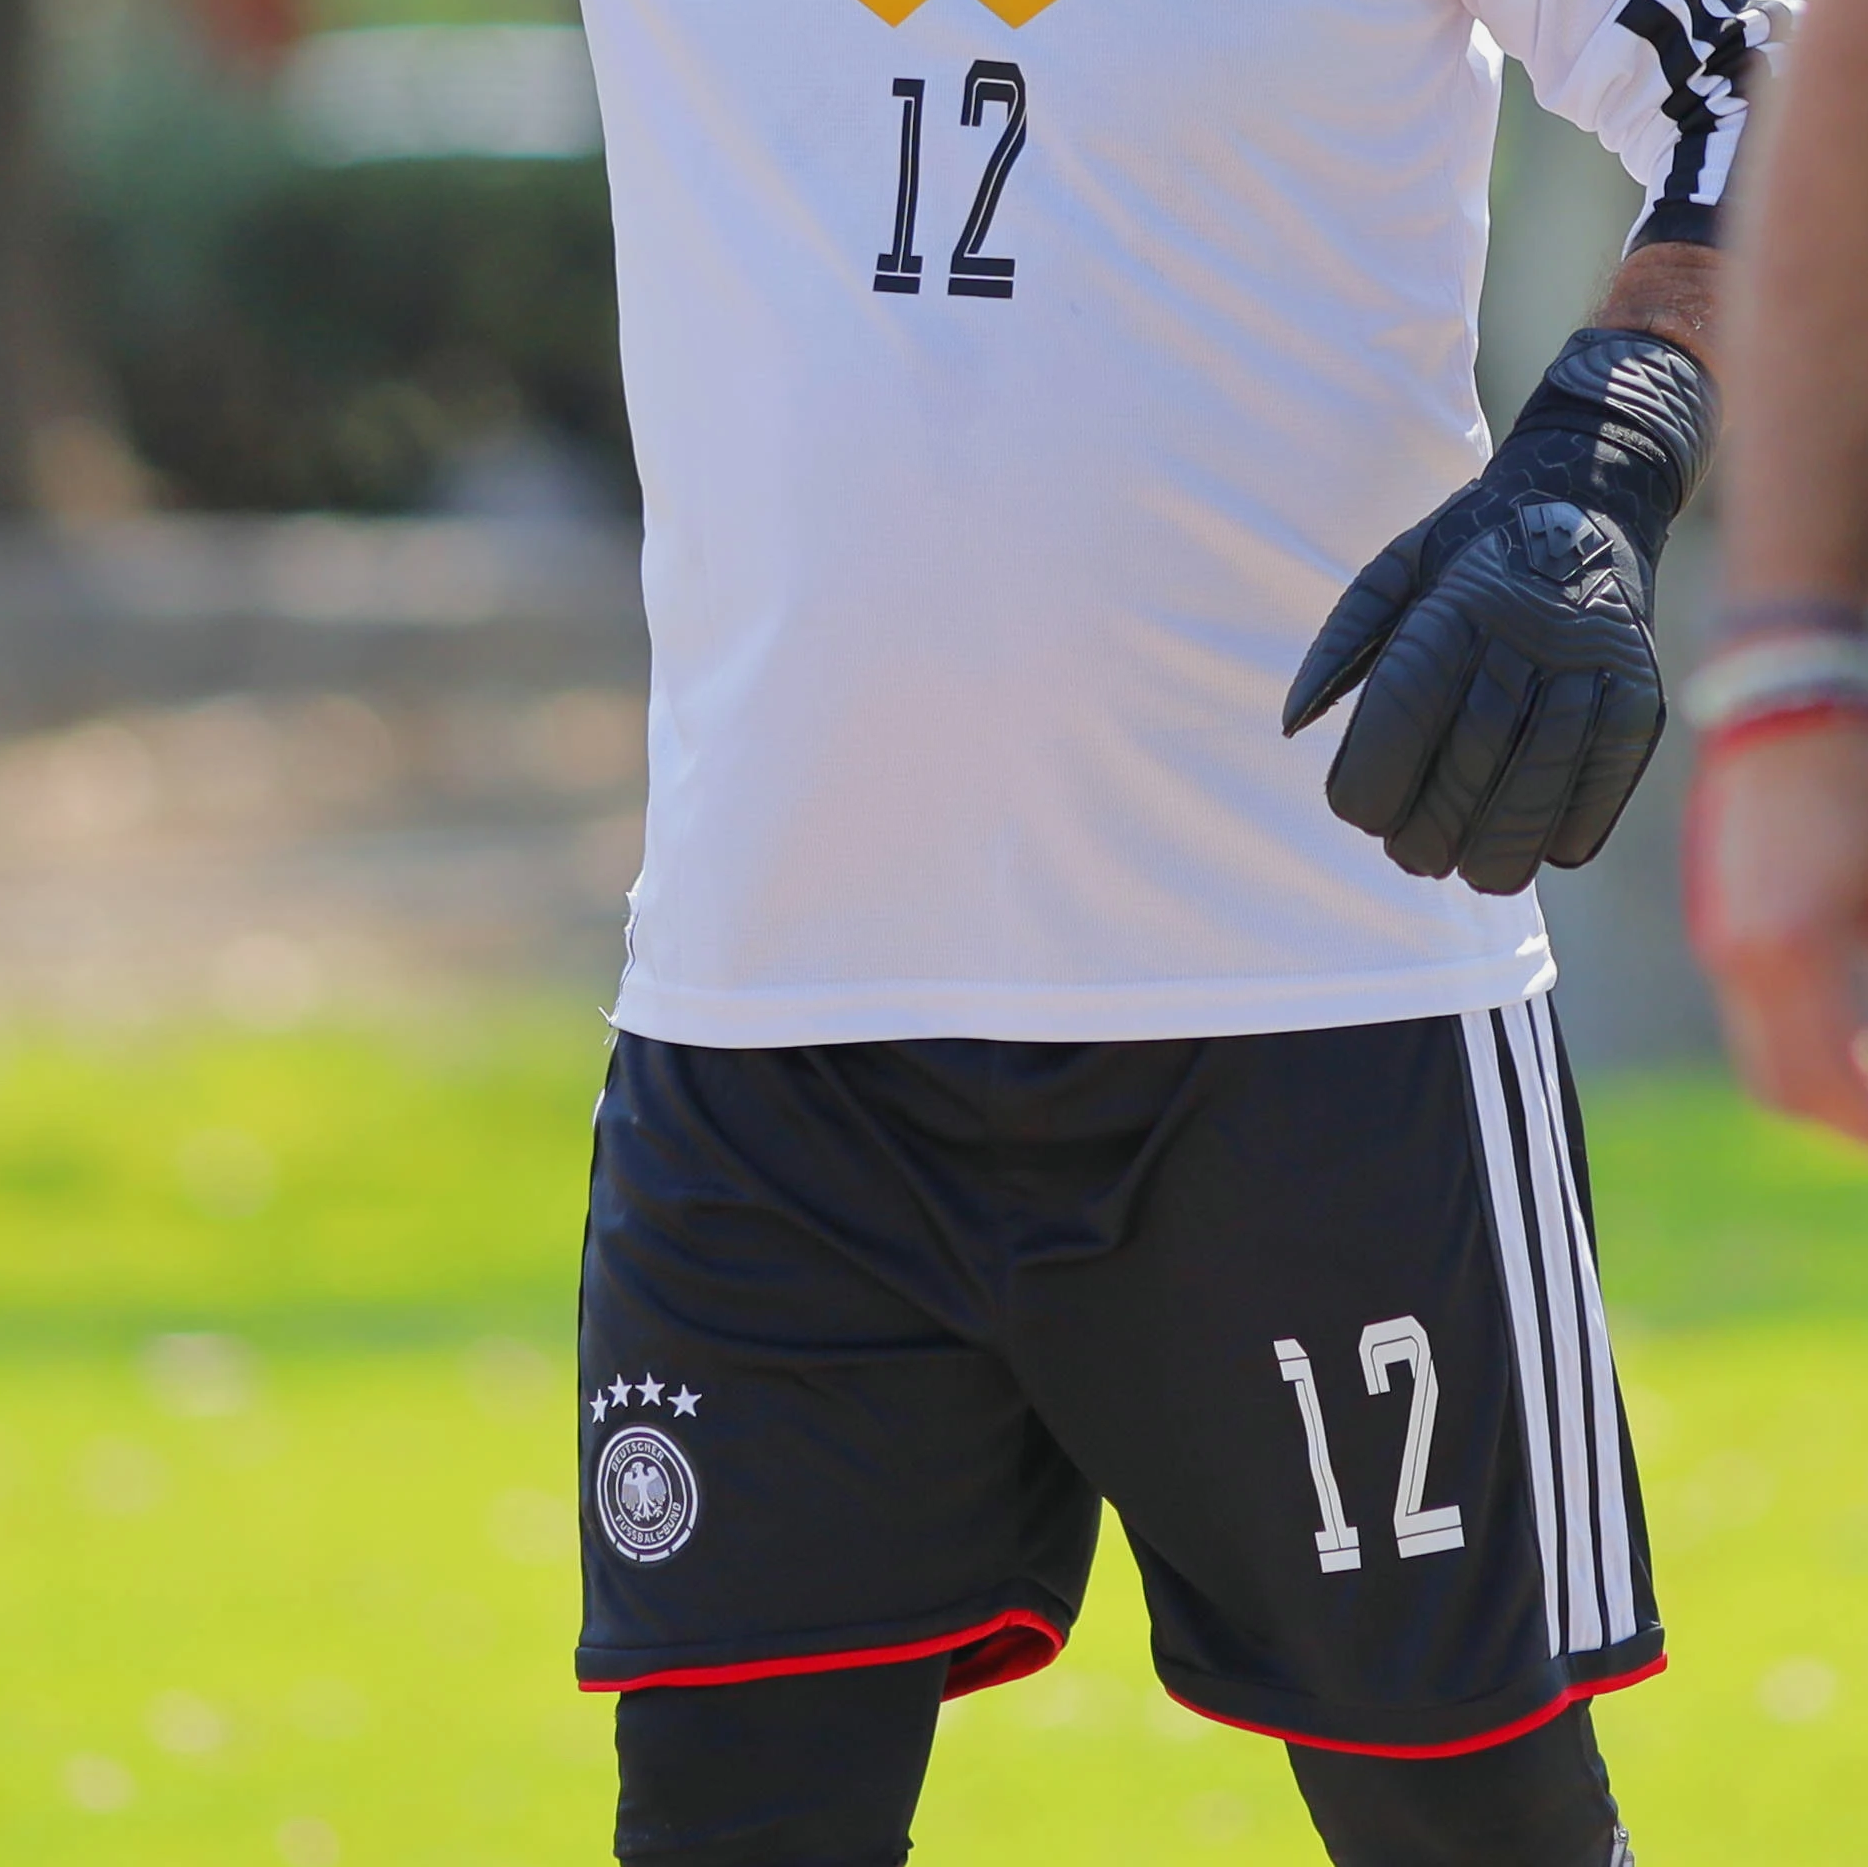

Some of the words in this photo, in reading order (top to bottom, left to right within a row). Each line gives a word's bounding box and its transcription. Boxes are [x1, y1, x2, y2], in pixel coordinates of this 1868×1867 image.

[873, 59, 1027, 300] 12
[611, 1441, 665, 1473] DEUTSCHER
[1273, 1314, 1465, 1573] 12
